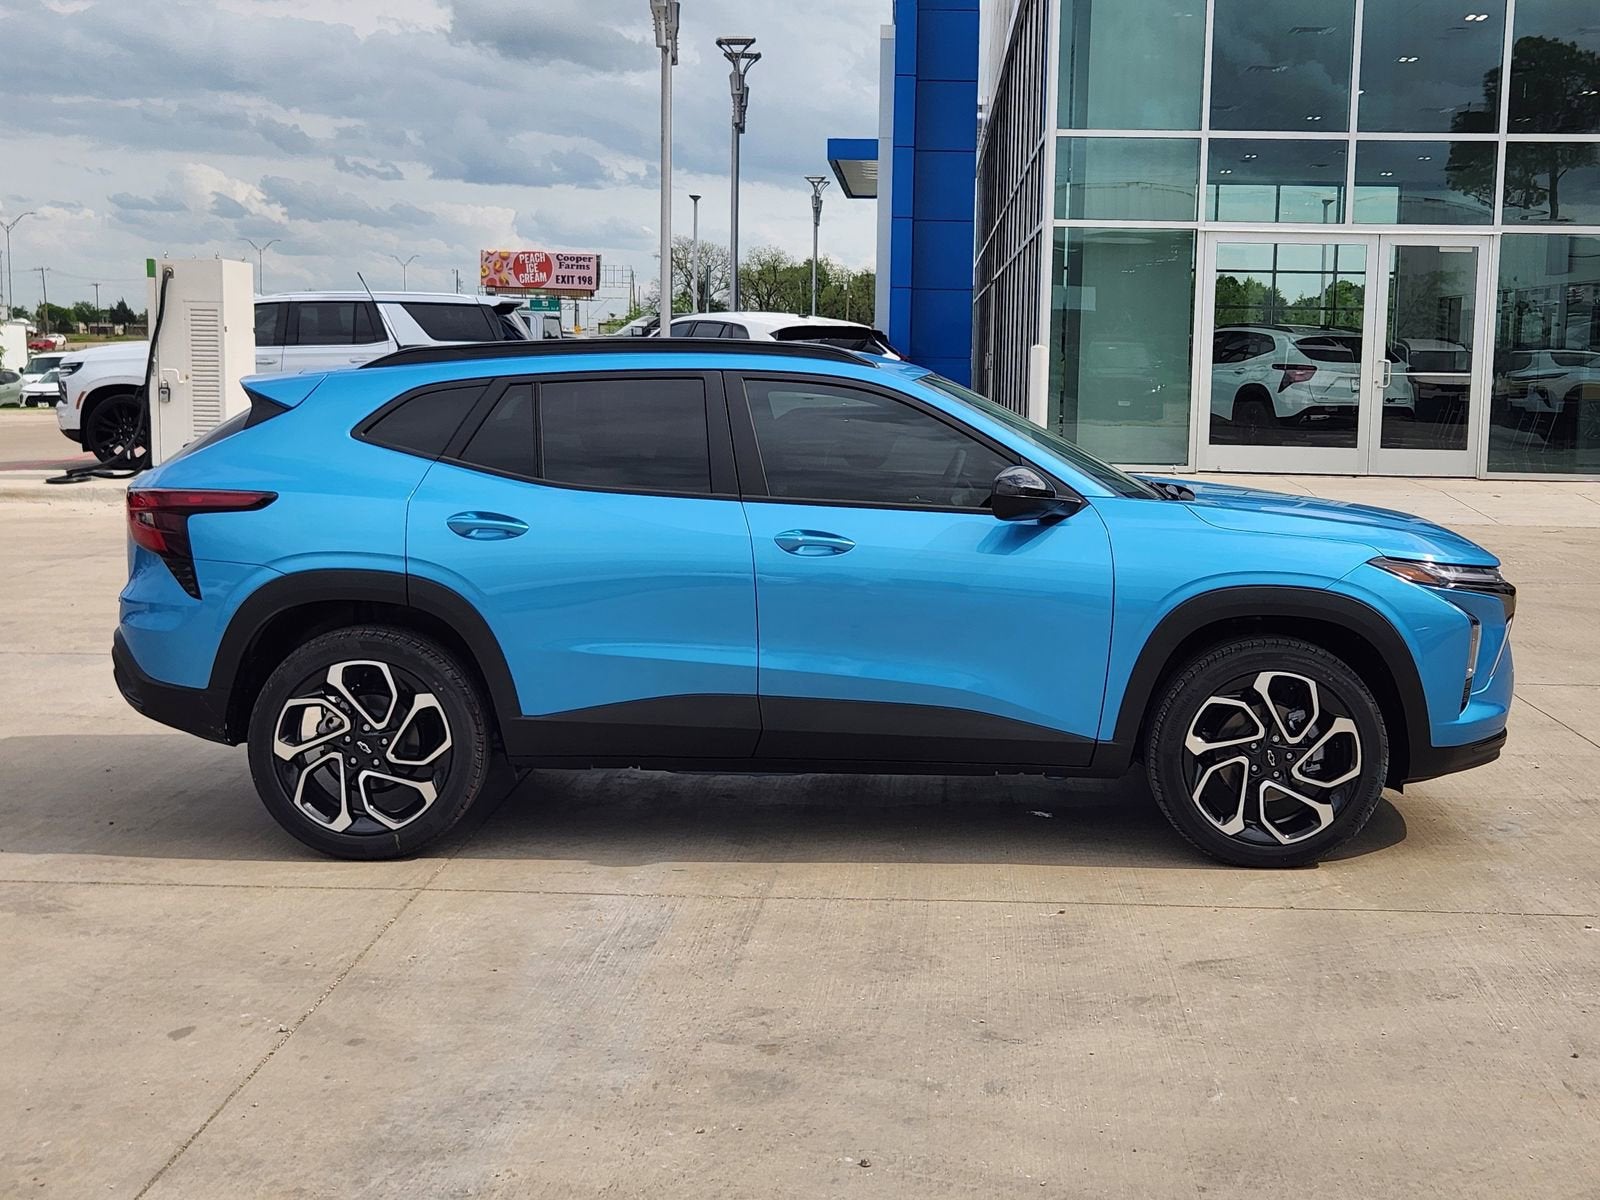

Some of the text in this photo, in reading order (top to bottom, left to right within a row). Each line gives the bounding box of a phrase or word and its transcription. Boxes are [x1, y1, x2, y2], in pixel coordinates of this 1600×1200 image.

[519, 253, 545, 264] PEACH
[556, 254, 593, 263] Cooper
[526, 264, 539, 273] ICE
[558, 262, 591, 270] Farms
[519, 273, 547, 284] CREAM
[555, 275, 593, 285] EXIT 198
